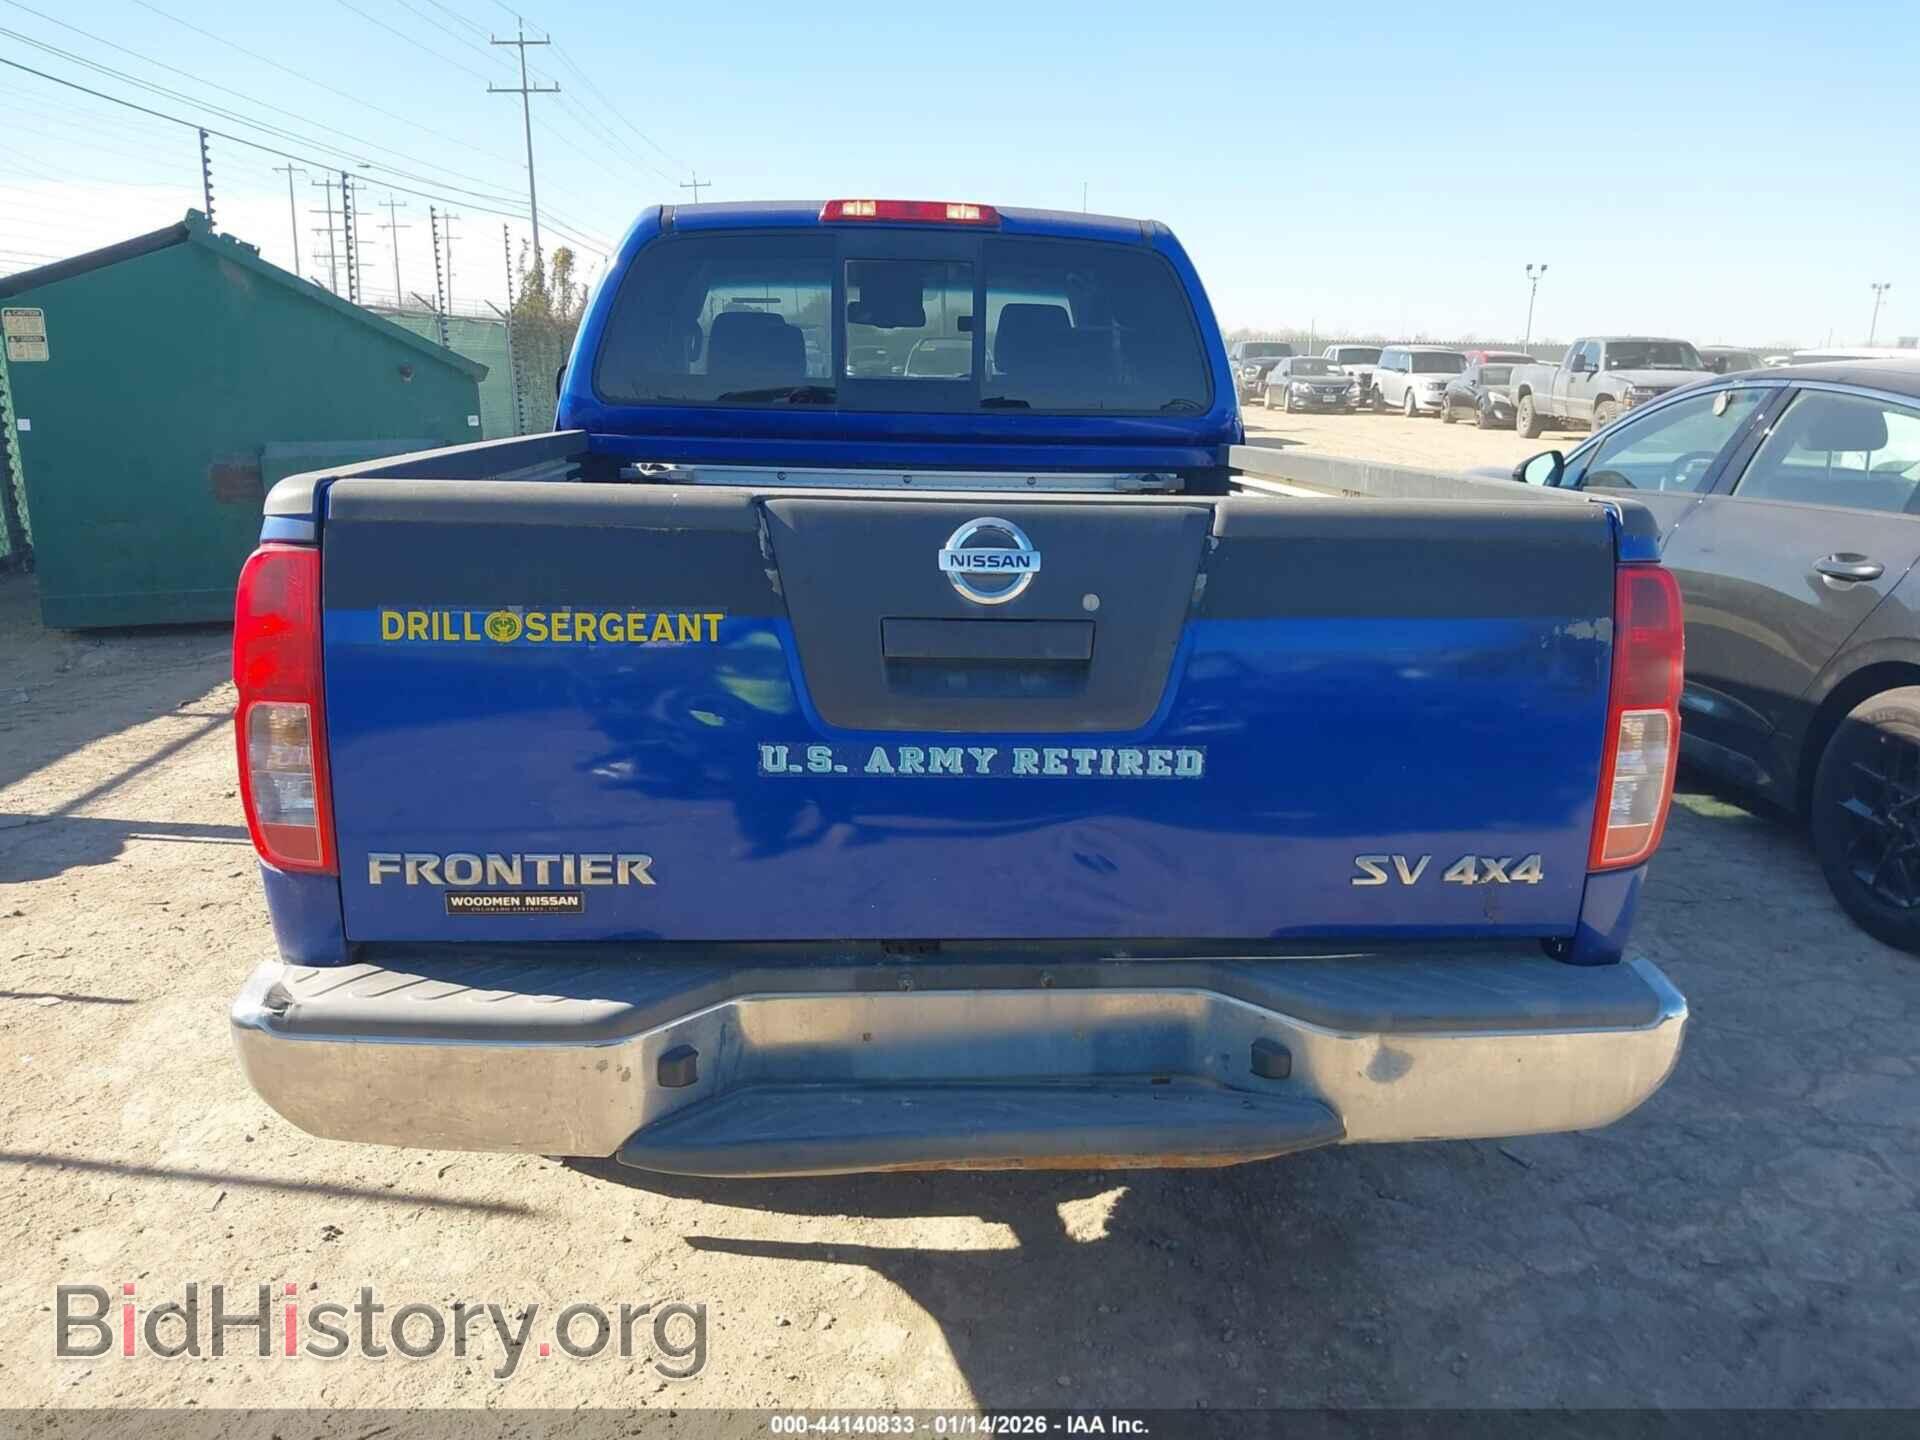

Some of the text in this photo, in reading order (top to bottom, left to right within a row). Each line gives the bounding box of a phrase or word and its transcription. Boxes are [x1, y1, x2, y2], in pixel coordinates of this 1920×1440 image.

[950, 554, 1030, 568] NISSAN
[381, 610, 725, 643] DRILL SERGEANT
[760, 744, 1205, 777] U.S. ARMY RETIRED
[367, 852, 657, 886] FRONTIER
[1351, 854, 1432, 886] SV
[450, 896, 578, 906] WOODMEN NISSAN
